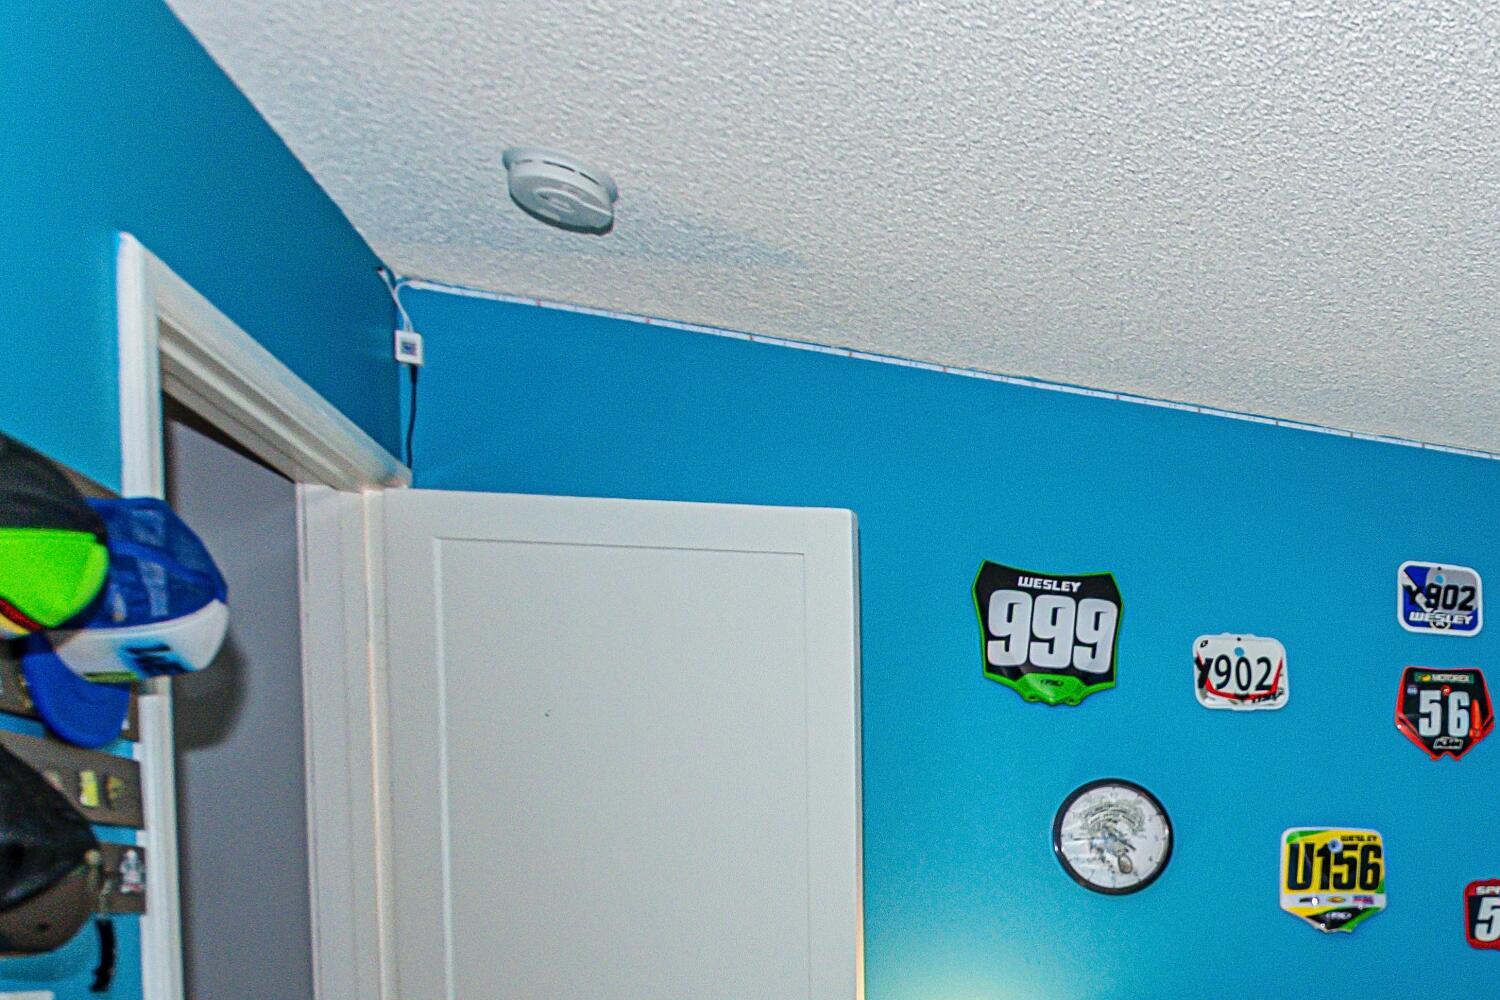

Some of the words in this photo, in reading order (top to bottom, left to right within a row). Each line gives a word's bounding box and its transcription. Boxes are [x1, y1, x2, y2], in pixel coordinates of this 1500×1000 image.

[1017, 576, 1081, 592] WESLEY
[1403, 583, 1476, 612] Y902
[987, 589, 1118, 674] 999
[1409, 611, 1473, 625] WESLEY
[1195, 654, 1272, 691] Y902
[1418, 689, 1470, 737] 56
[1287, 842, 1382, 891] U156
